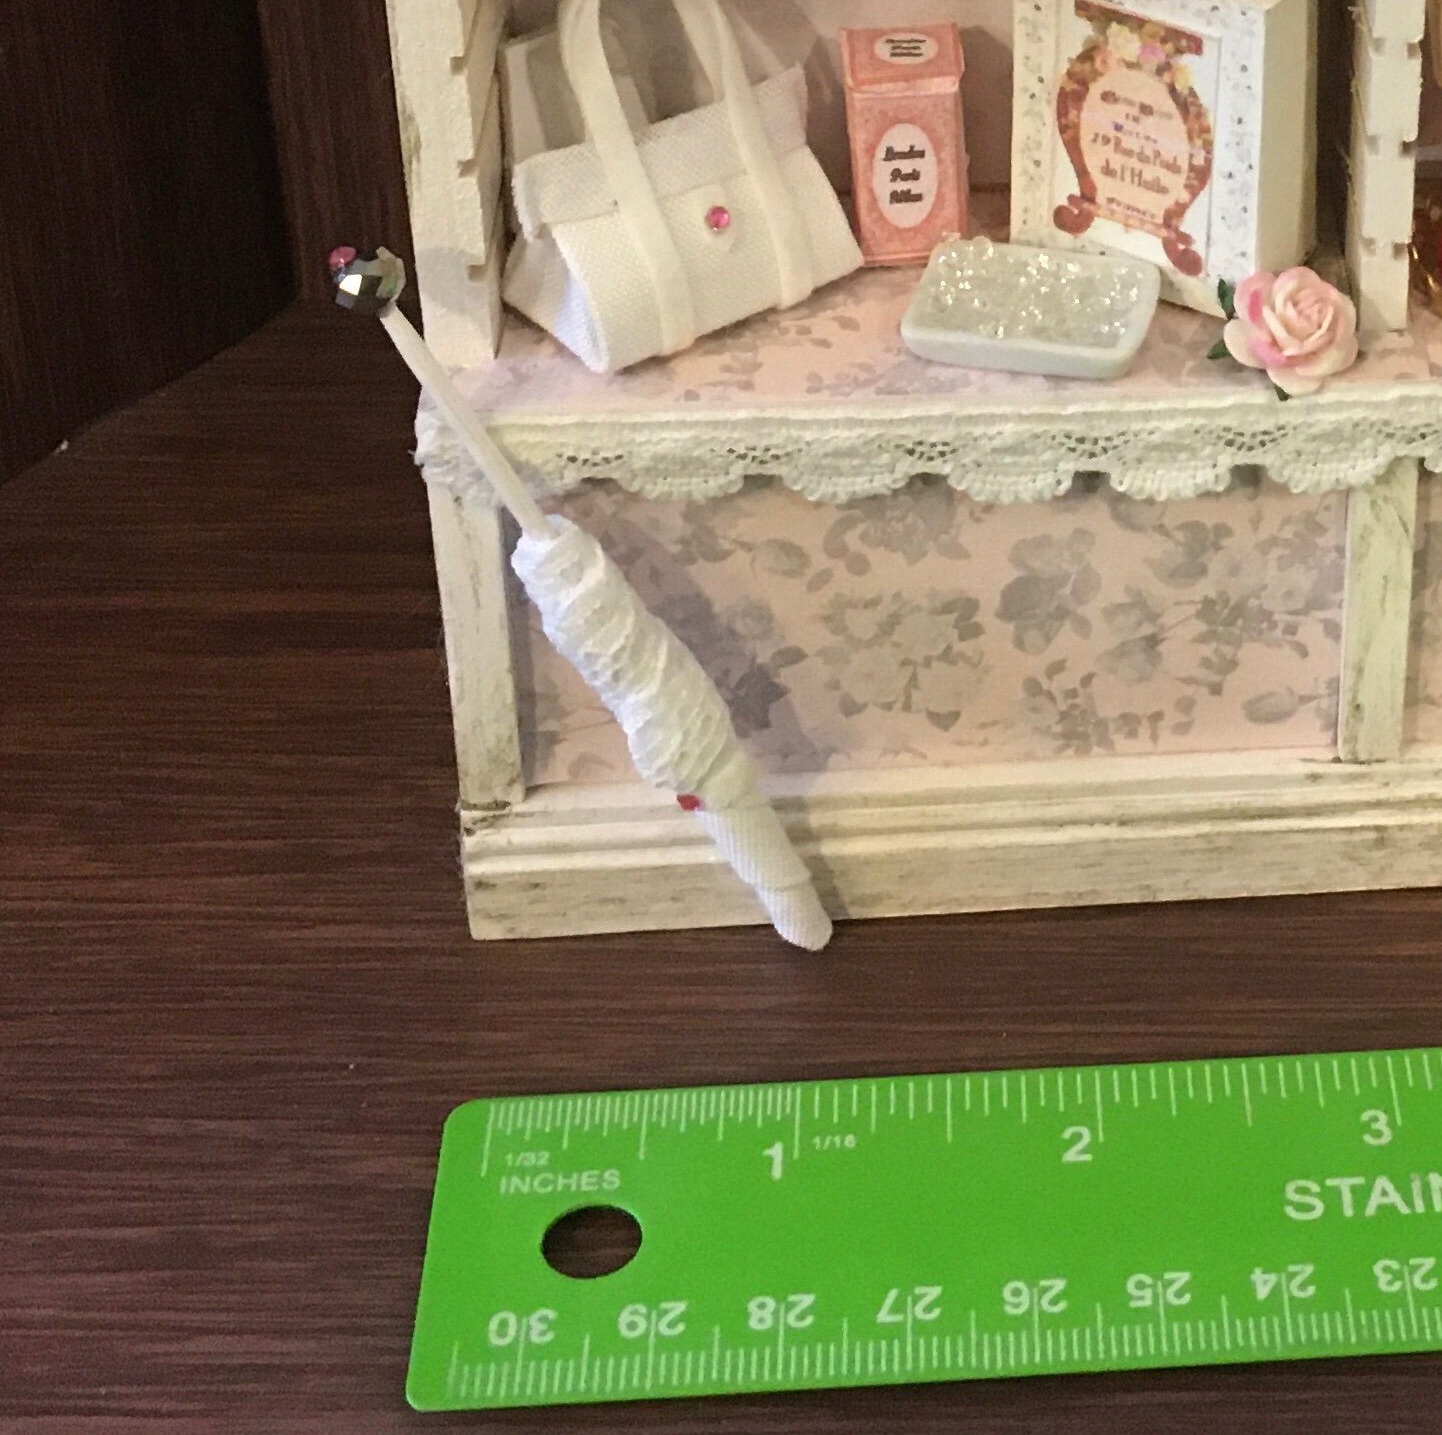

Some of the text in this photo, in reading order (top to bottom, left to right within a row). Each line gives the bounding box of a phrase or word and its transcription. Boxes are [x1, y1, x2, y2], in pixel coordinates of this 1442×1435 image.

[763, 1142, 783, 1179] 1
[1061, 1126, 1093, 1162] 2
[1360, 1109, 1393, 1145] 3
[812, 1134, 856, 1150] 1/16
[500, 1170, 621, 1193] INCHES
[1126, 1271, 1191, 1308] 25
[1250, 1264, 1316, 1301] 24
[1372, 1257, 1438, 1293] 23
[747, 1293, 817, 1330] 28
[876, 1286, 942, 1323] 27
[1002, 1278, 1068, 1315] 26
[488, 1308, 557, 1346] 30
[617, 1301, 688, 1339] 29
